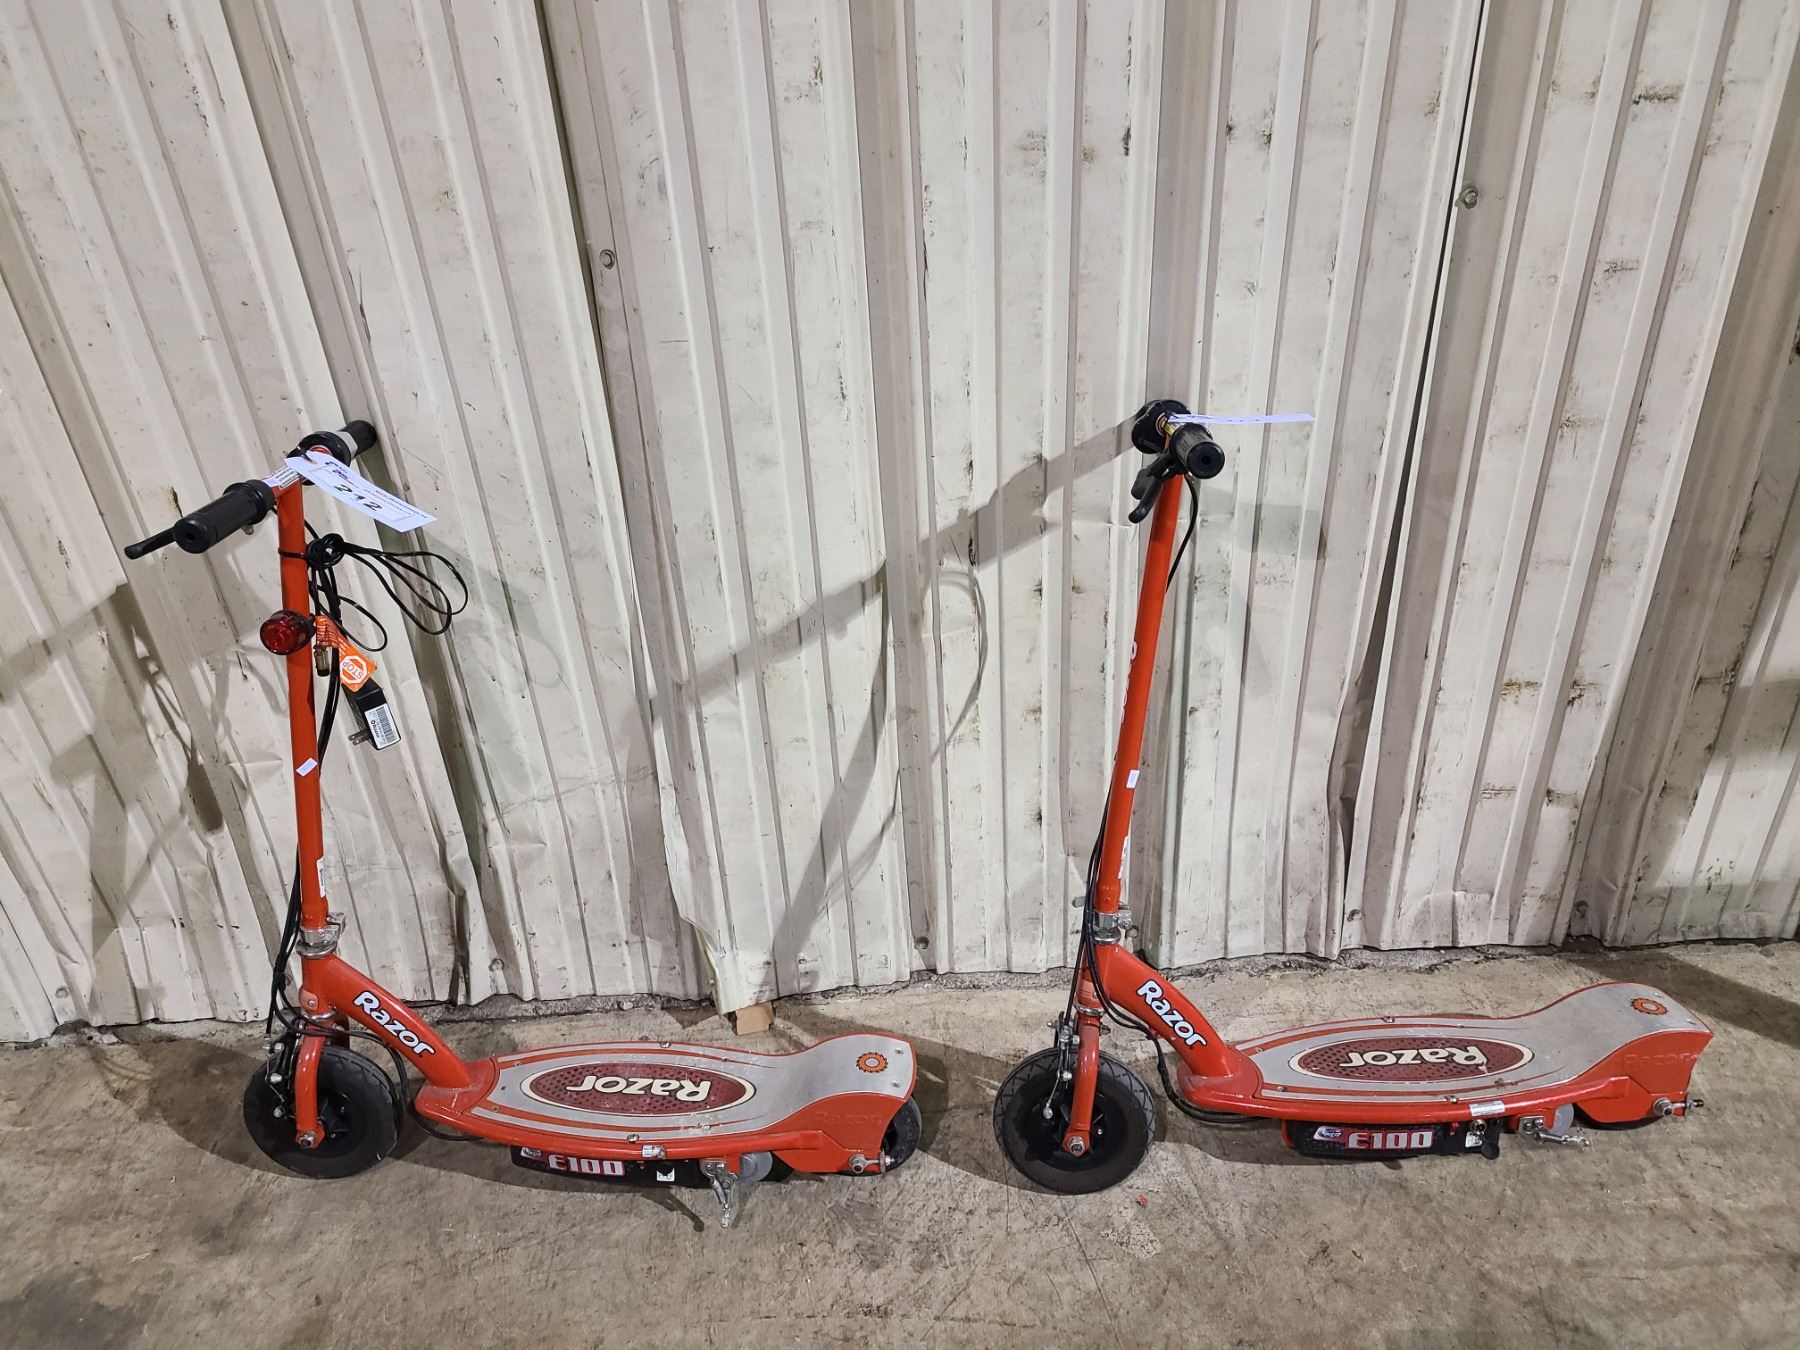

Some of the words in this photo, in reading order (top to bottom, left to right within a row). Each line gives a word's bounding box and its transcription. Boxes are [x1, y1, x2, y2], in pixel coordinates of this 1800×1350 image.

[333, 484, 383, 511] 212
[342, 660, 364, 680] STOP
[352, 990, 436, 1055] Razor
[1136, 979, 1208, 1046] Razor
[1339, 1046, 1488, 1067] Razor
[566, 1075, 712, 1102] Razor
[1346, 1129, 1434, 1150] E100
[548, 1154, 625, 1176] E100
